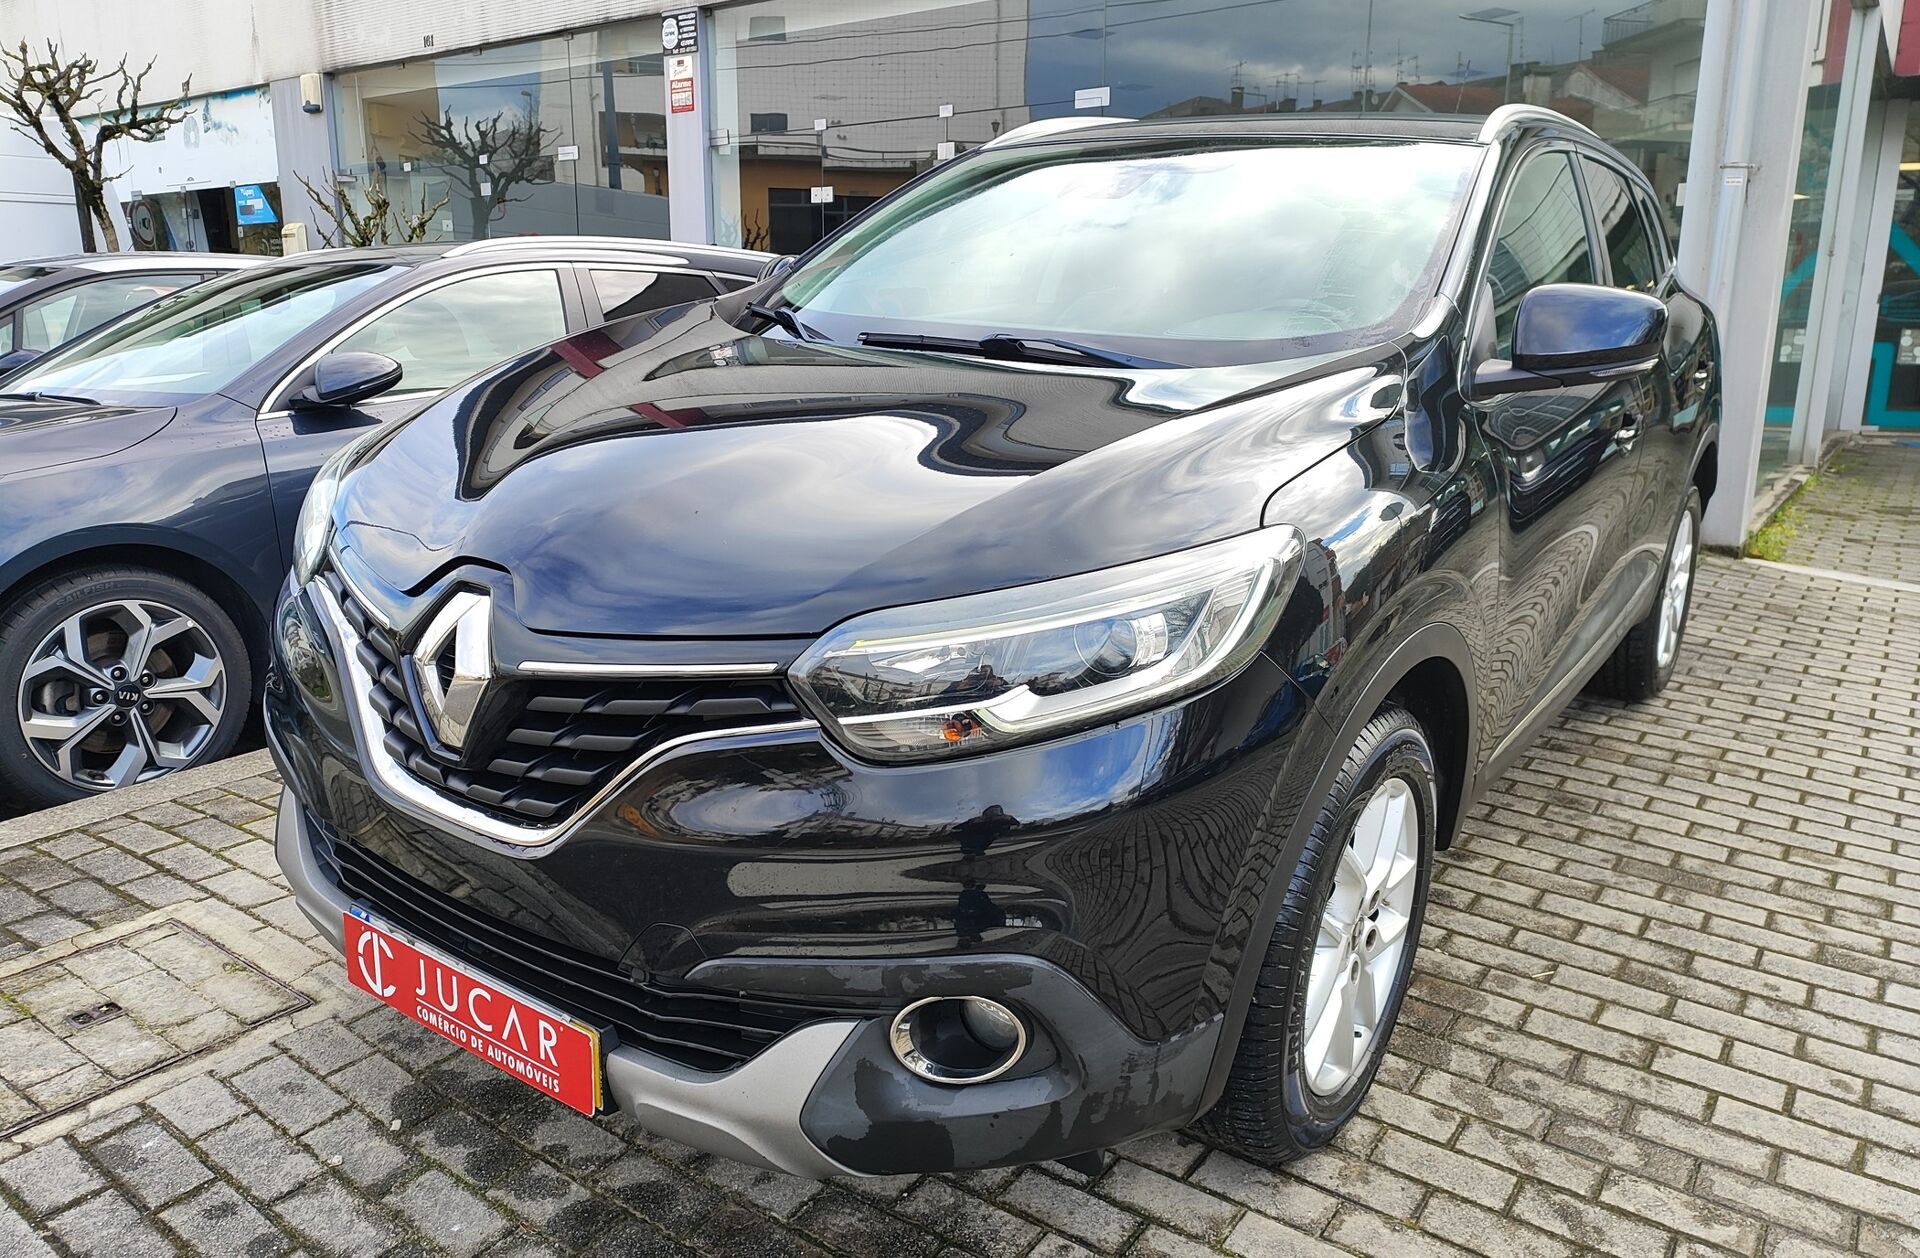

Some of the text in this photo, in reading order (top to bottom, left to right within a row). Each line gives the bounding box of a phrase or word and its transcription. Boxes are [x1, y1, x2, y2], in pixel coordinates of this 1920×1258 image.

[118, 690, 139, 702] KIA
[415, 959, 559, 1068] JUCAR
[416, 1005, 560, 1094] COMÉRCIO DE AUTOMÓVEIS
